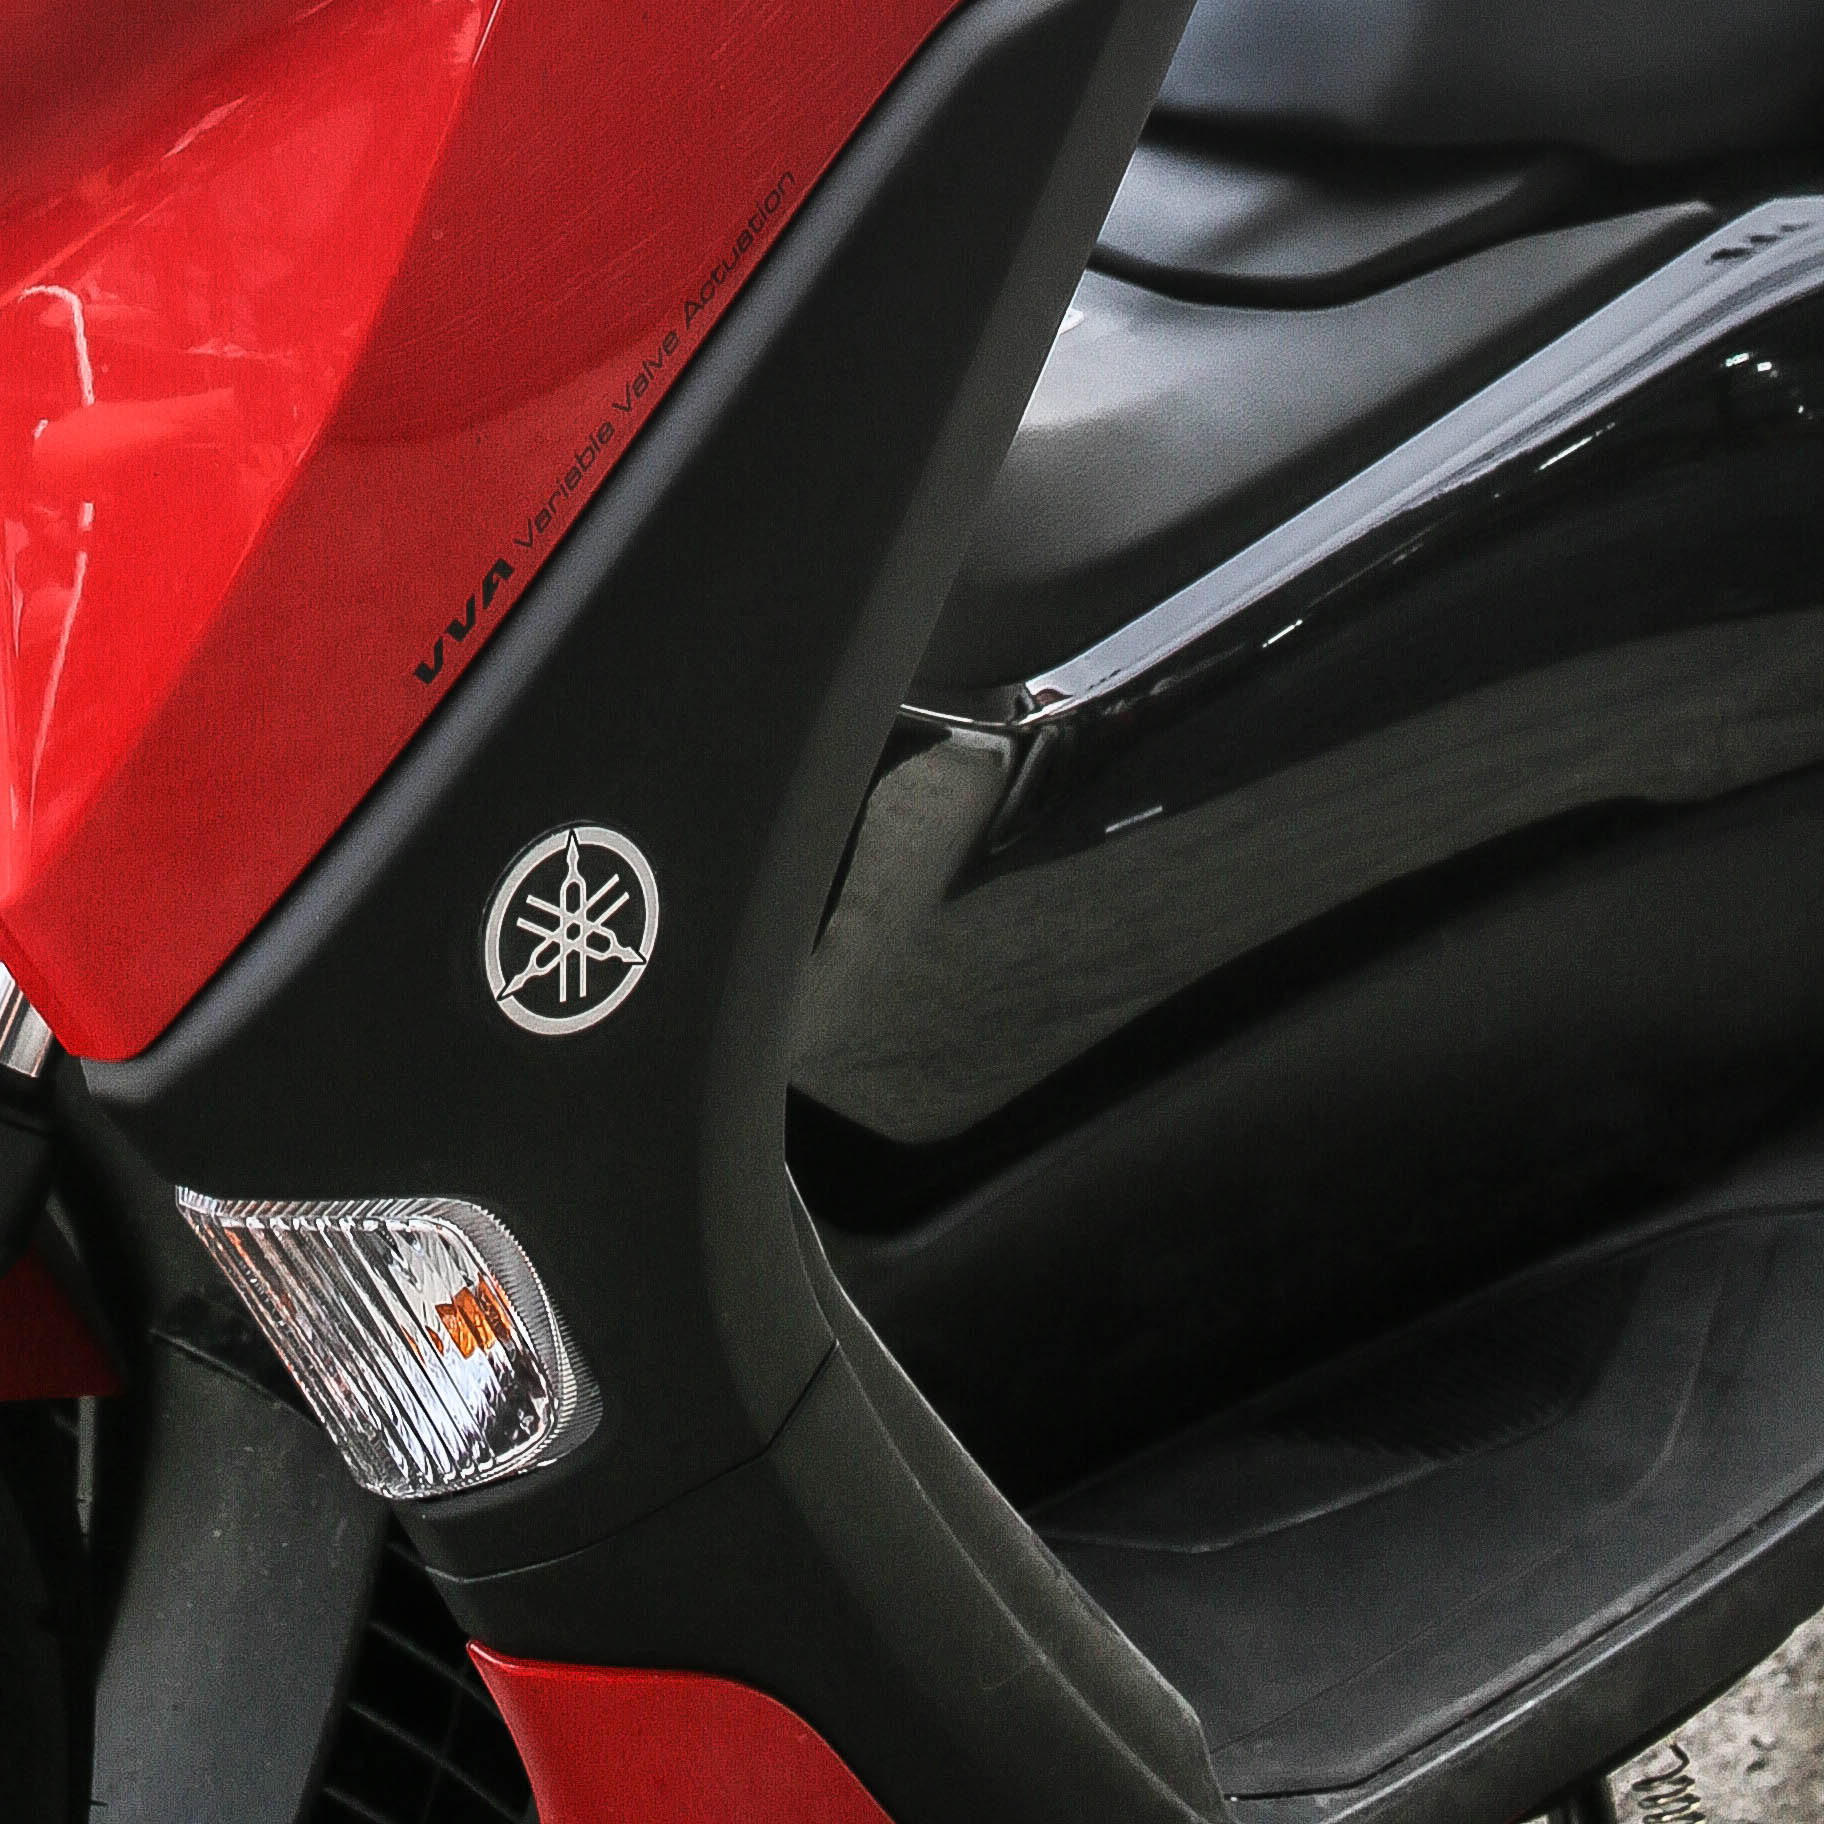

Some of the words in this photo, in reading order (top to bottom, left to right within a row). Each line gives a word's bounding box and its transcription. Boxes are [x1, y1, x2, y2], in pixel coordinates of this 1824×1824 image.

[412, 557, 515, 686] VVA
[513, 421, 615, 550] Variable
[612, 331, 680, 414] Valve
[683, 170, 796, 330] Actuation
